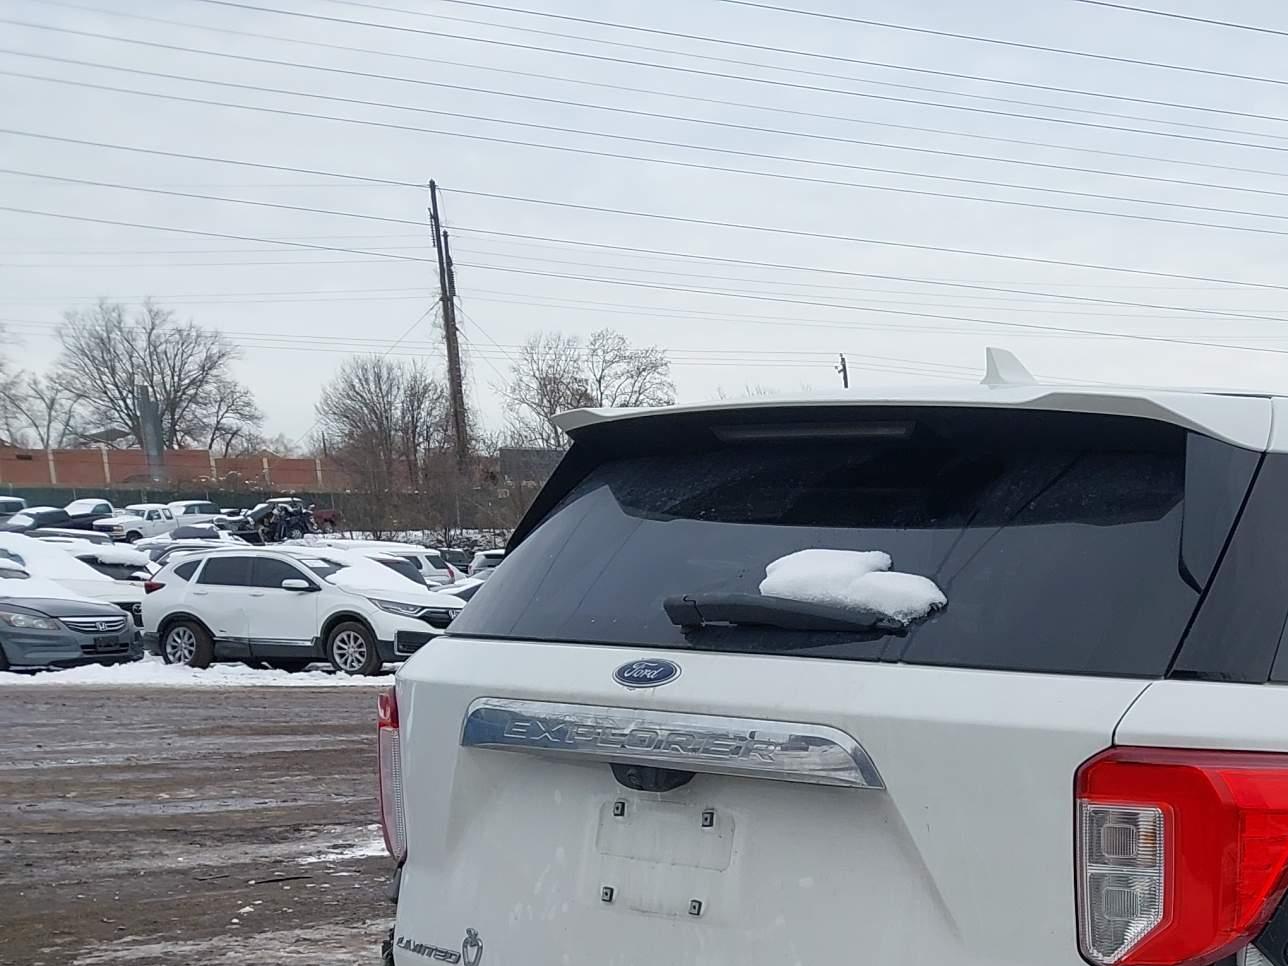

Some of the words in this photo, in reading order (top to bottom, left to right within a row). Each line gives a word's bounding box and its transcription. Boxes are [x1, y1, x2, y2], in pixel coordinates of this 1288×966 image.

[623, 661, 664, 679] Ford
[503, 719, 778, 762] EXPLORER
[396, 936, 461, 964] LIMITED
